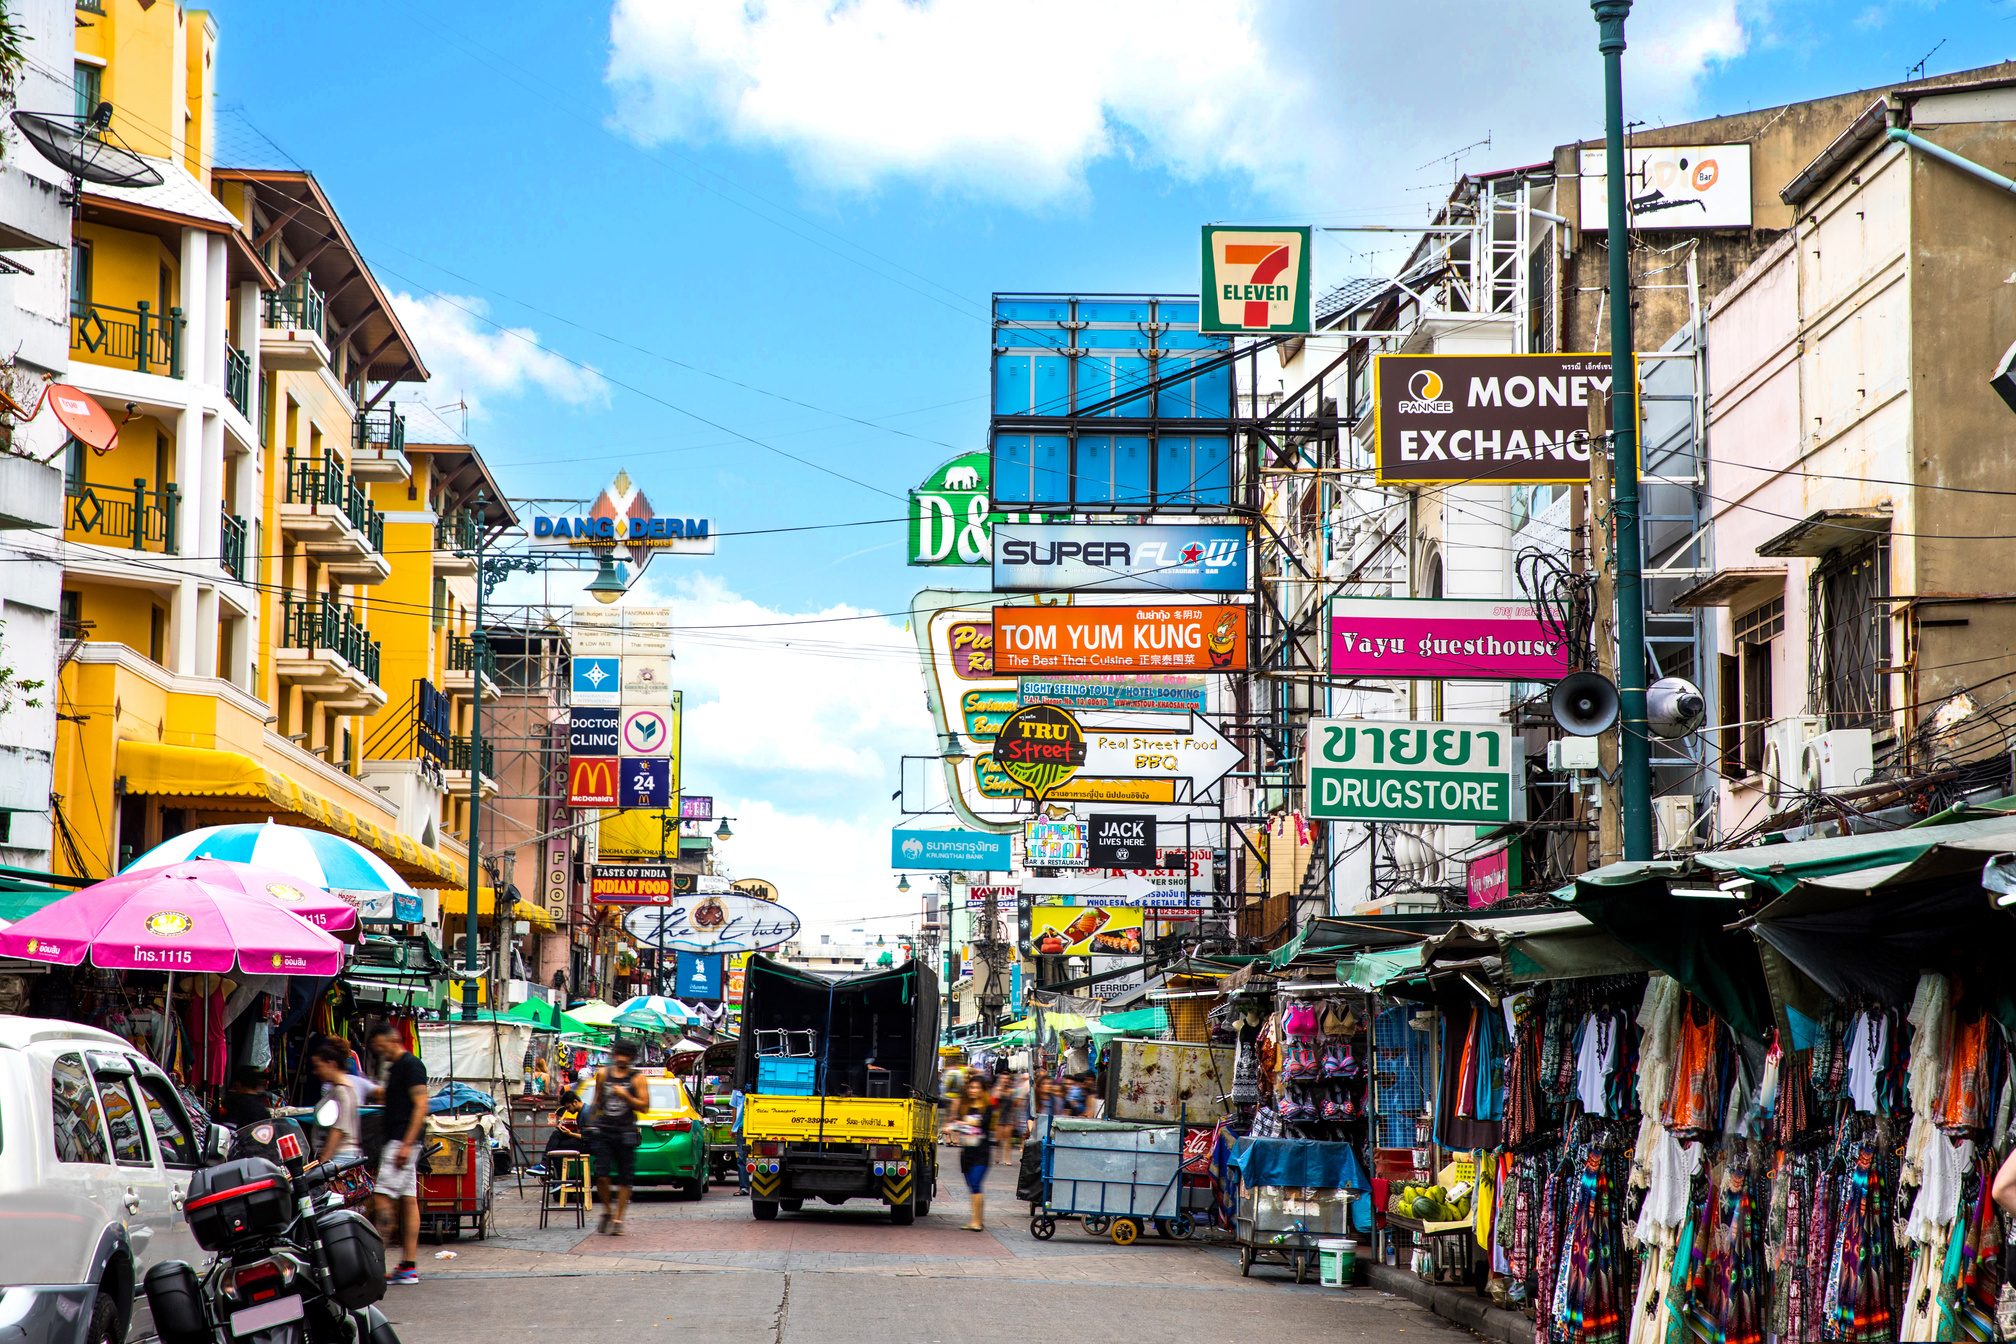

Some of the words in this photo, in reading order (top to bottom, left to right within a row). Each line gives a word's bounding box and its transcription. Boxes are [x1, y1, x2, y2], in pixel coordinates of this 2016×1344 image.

[1699, 172, 1713, 181] Bar
[1225, 244, 1289, 328] 7
[1467, 375, 1613, 408] MONEY
[1399, 401, 1453, 414] PANNEE
[534, 516, 615, 538] DANG
[629, 517, 709, 539] DERM
[646, 539, 673, 547] Hotel
[1173, 610, 1202, 620] 冬阴功
[1001, 625, 1057, 650] TOM
[1066, 625, 1124, 650] YUM
[1134, 623, 1202, 649] KUNG
[1341, 632, 1406, 658] Vayu
[1418, 633, 1559, 659] guesthouse
[1008, 654, 1029, 666] The
[1033, 655, 1058, 666] Best
[1063, 655, 1087, 666] Thai
[1090, 655, 1133, 666] Cuisine
[1139, 654, 1195, 666] 正宗泰国菜
[1098, 675, 1125, 683] TRAIN
[1136, 675, 1152, 684] BUS
[1163, 675, 1187, 685] BOAT
[1024, 683, 1052, 694] SIGHT
[1054, 684, 1087, 695] SEEING
[1089, 685, 1114, 696] TOUR
[1125, 686, 1154, 698] HOTEL
[1157, 688, 1200, 699] BOOKING
[1041, 696, 1063, 705] License
[570, 719, 619, 728] DOCTOR
[1018, 721, 1070, 741] TRU
[570, 734, 619, 746] CLINIC
[1098, 736, 1128, 750] Real
[1132, 737, 1180, 750] Street
[1184, 737, 1218, 751] Food
[1322, 725, 1500, 768] ขายยา
[1008, 739, 1074, 763] Street
[1134, 754, 1179, 772] BBQ
[552, 733, 568, 840] INDIAN
[633, 775, 656, 791] 24
[1321, 776, 1499, 811] DRUGSTORE
[1099, 822, 1144, 838] JACK
[926, 840, 999, 854] ธนาคารกรุงไทย
[1099, 838, 1121, 846] LIVES
[596, 868, 625, 877] TASTE
[627, 869, 639, 877] OF
[640, 869, 667, 878] INDIA
[549, 852, 566, 920] FOOD
[593, 879, 636, 893] INDIAN
[638, 880, 669, 894] FOOD
[970, 886, 1015, 900] KAWIN
[338, 893, 356, 901] Happy
[644, 907, 695, 941] The
[719, 916, 791, 941] Club
[133, 945, 192, 964] โทร.1115
[284, 957, 307, 967] ออมสิน
[1094, 983, 1141, 992] FERRIDE
[791, 1117, 838, 1125] 087-239947
[1182, 1128, 1212, 1153] ola
